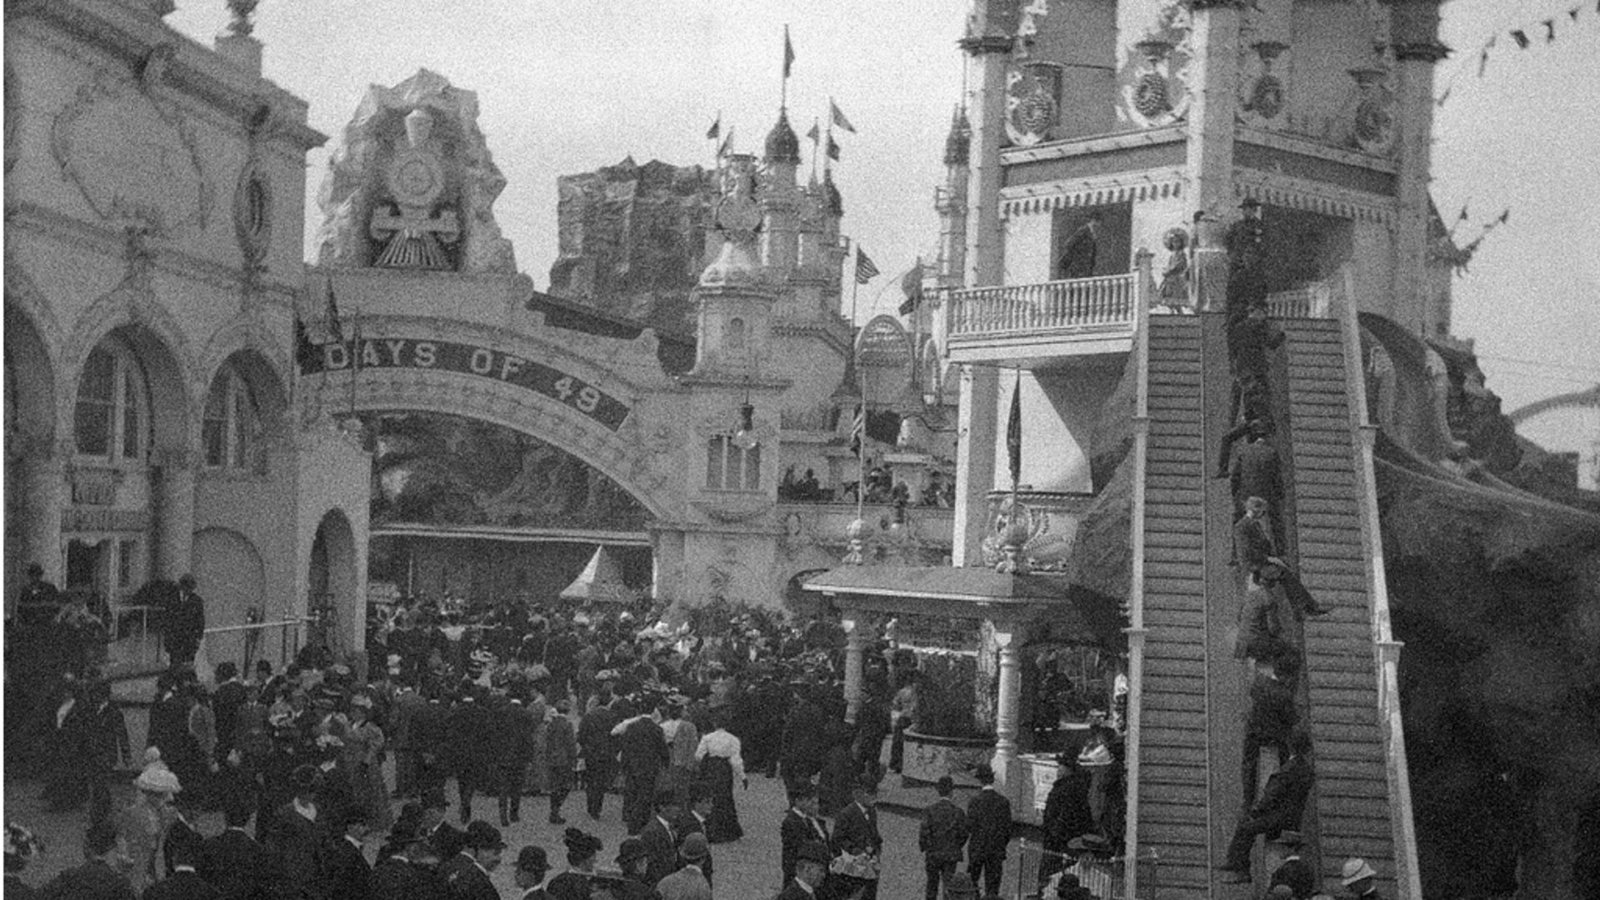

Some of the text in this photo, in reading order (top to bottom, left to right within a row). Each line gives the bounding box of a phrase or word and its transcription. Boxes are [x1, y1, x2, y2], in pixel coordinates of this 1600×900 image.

[326, 340, 601, 413] DAYS OF 49
